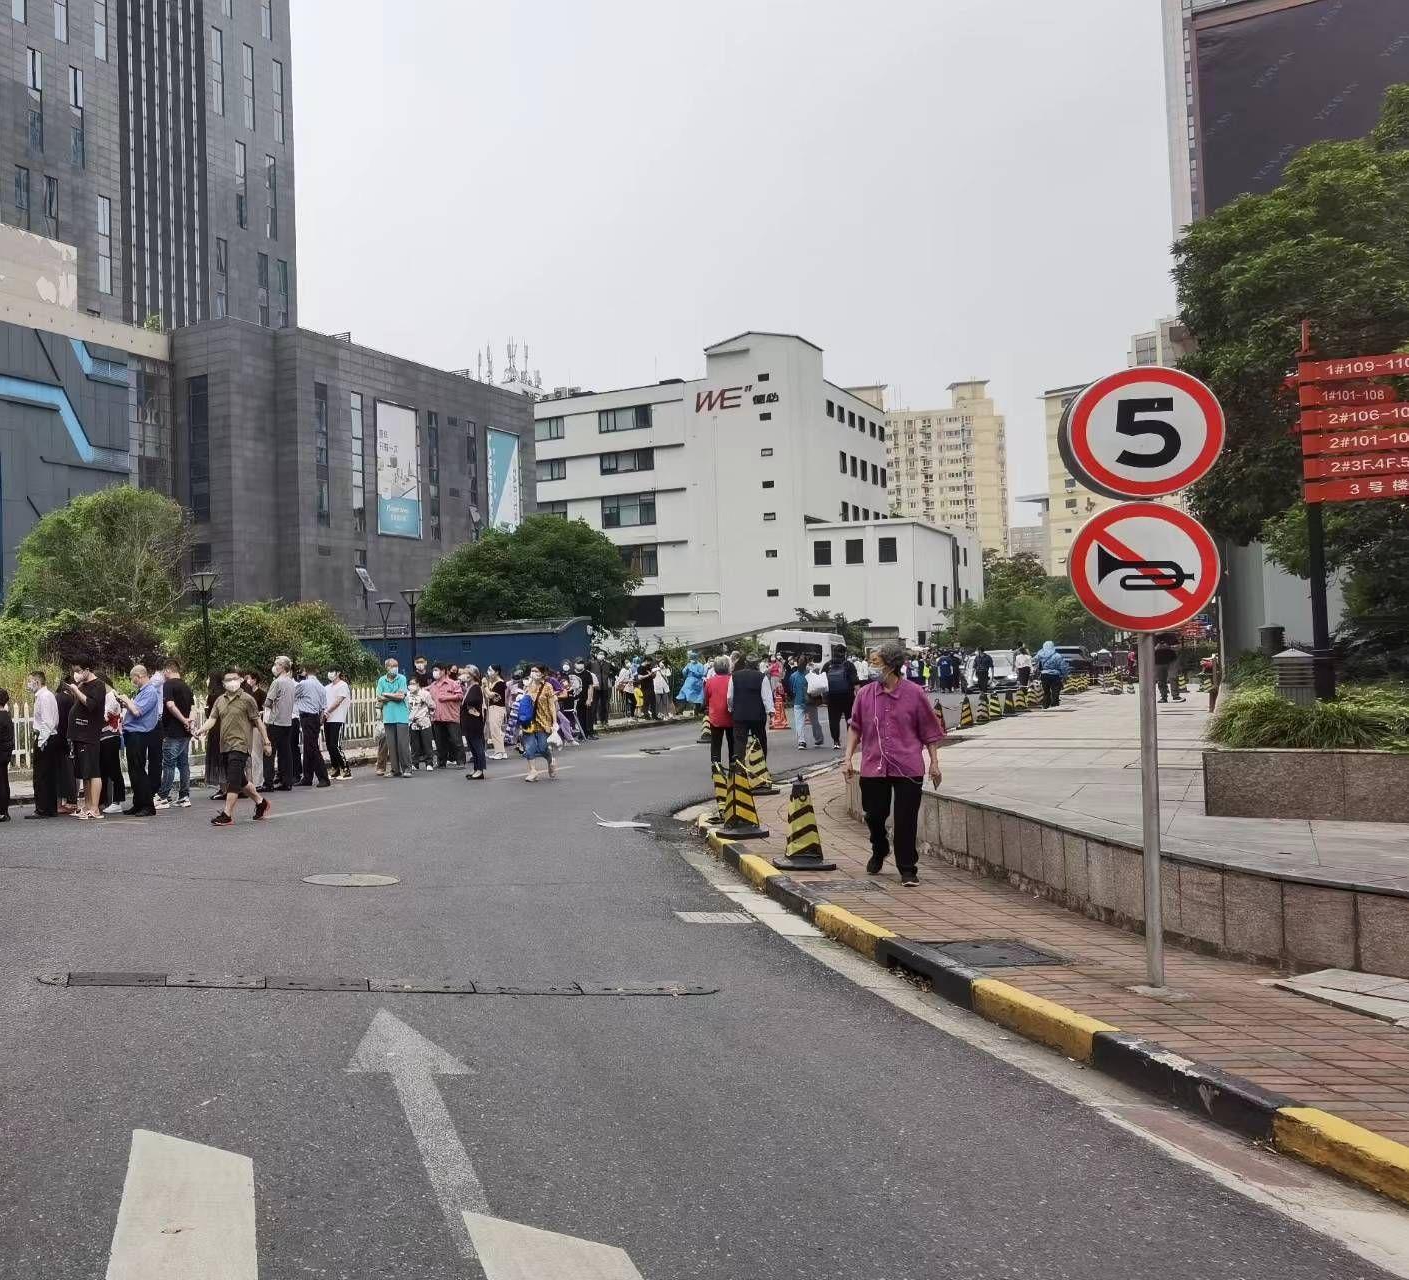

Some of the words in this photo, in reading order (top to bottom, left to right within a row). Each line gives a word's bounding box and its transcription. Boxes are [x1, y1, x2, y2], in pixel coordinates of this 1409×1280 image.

[1322, 389, 1385, 401] 1#101-108
[1115, 397, 1182, 468] 5
[1329, 432, 1409, 449] 2#101-10
